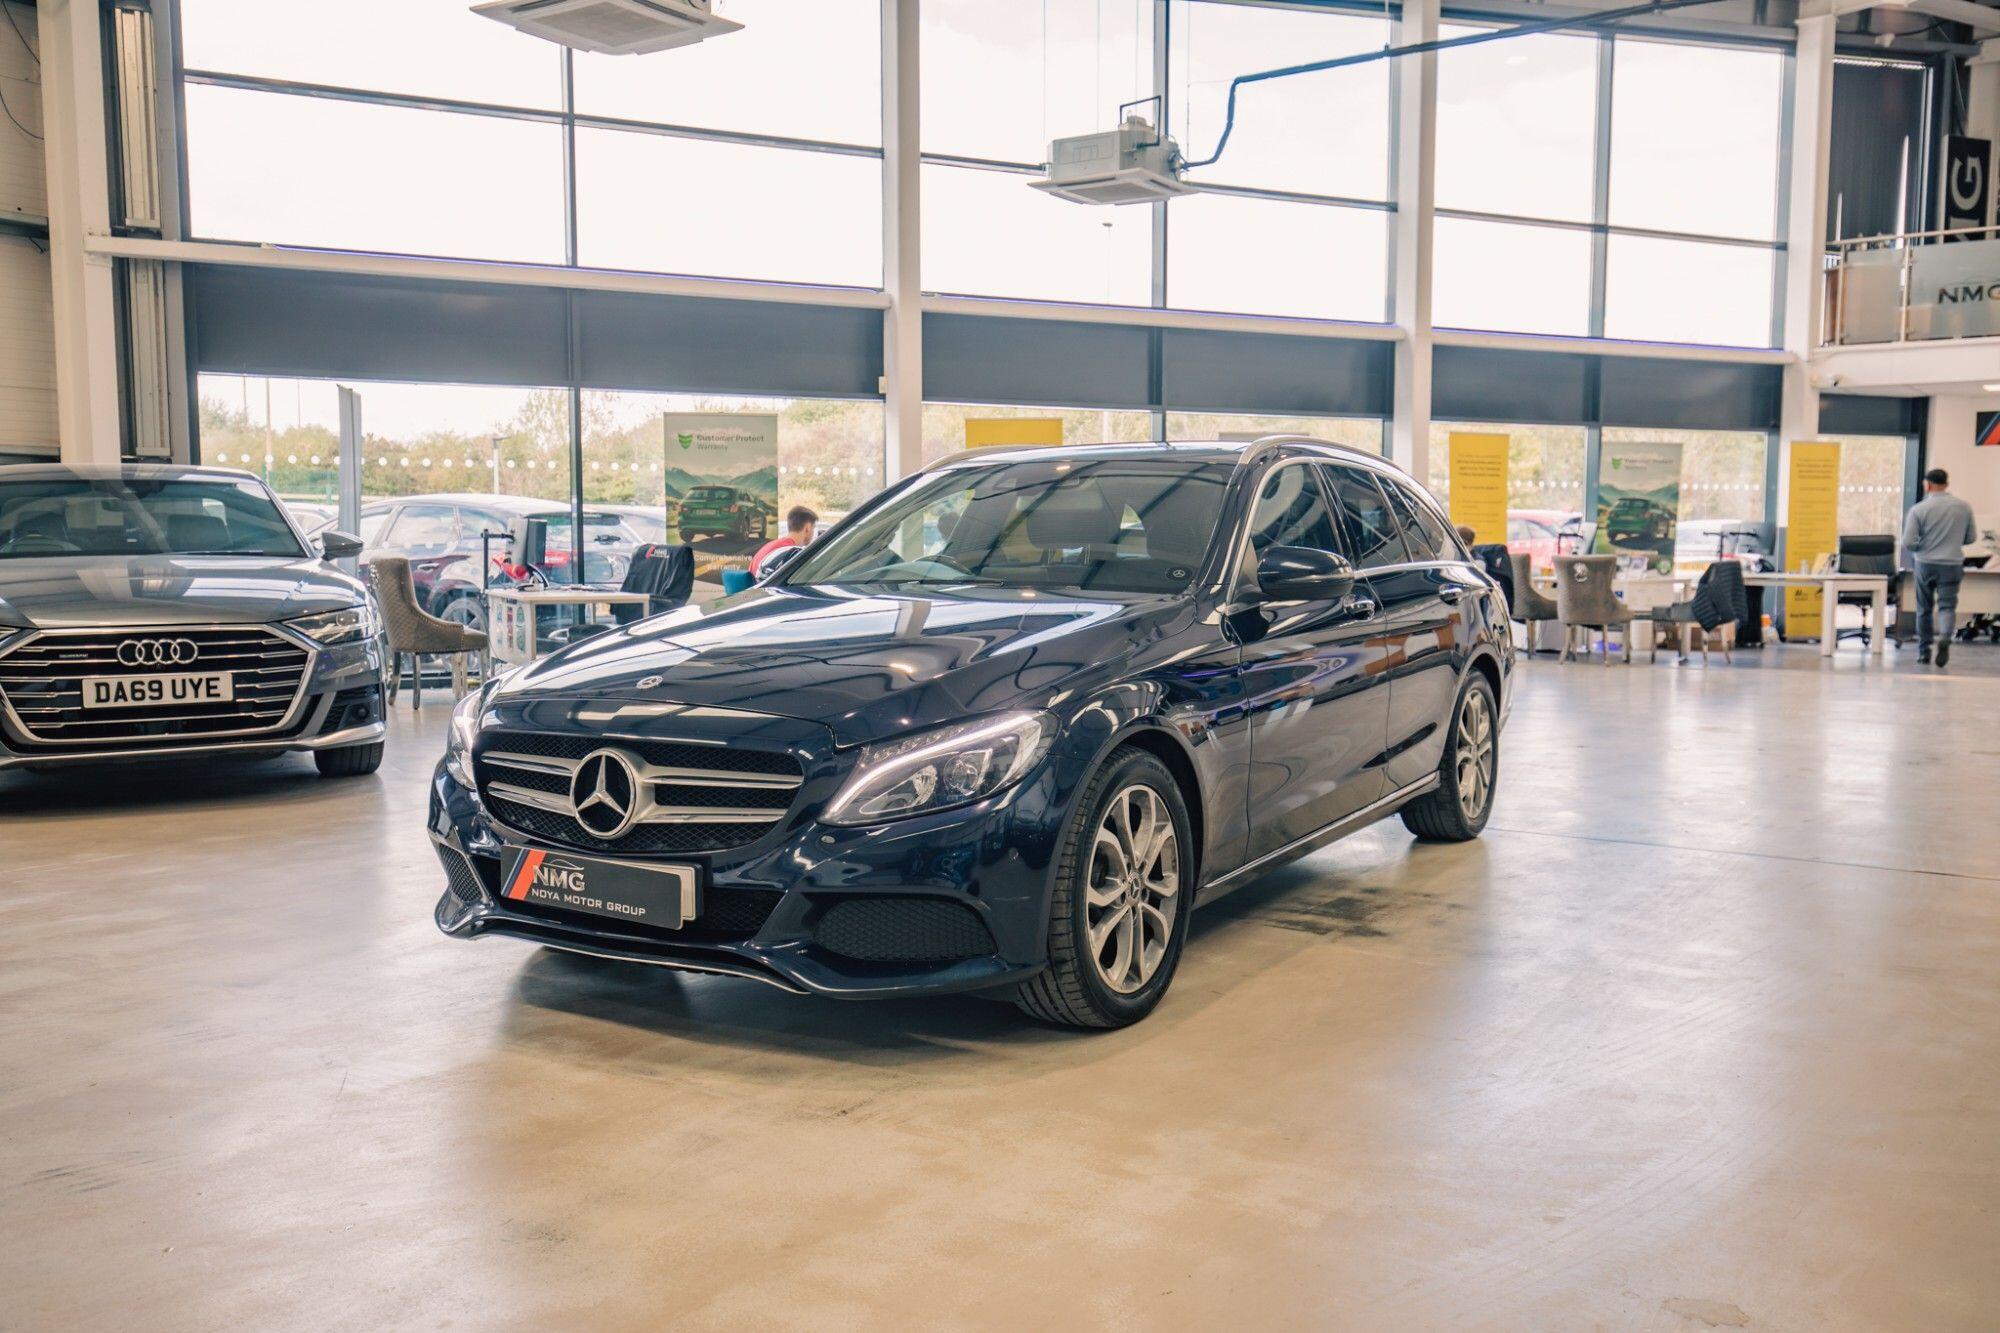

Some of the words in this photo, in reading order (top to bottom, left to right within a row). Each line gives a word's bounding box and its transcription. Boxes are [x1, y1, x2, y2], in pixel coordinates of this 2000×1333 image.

[735, 434, 764, 442] Protect
[94, 680, 163, 703] DA69
[171, 677, 220, 700] UYE
[533, 864, 585, 892] NMG
[531, 888, 560, 901] NOYA
[564, 894, 602, 909] MOTOR
[606, 901, 646, 916] GROUP
